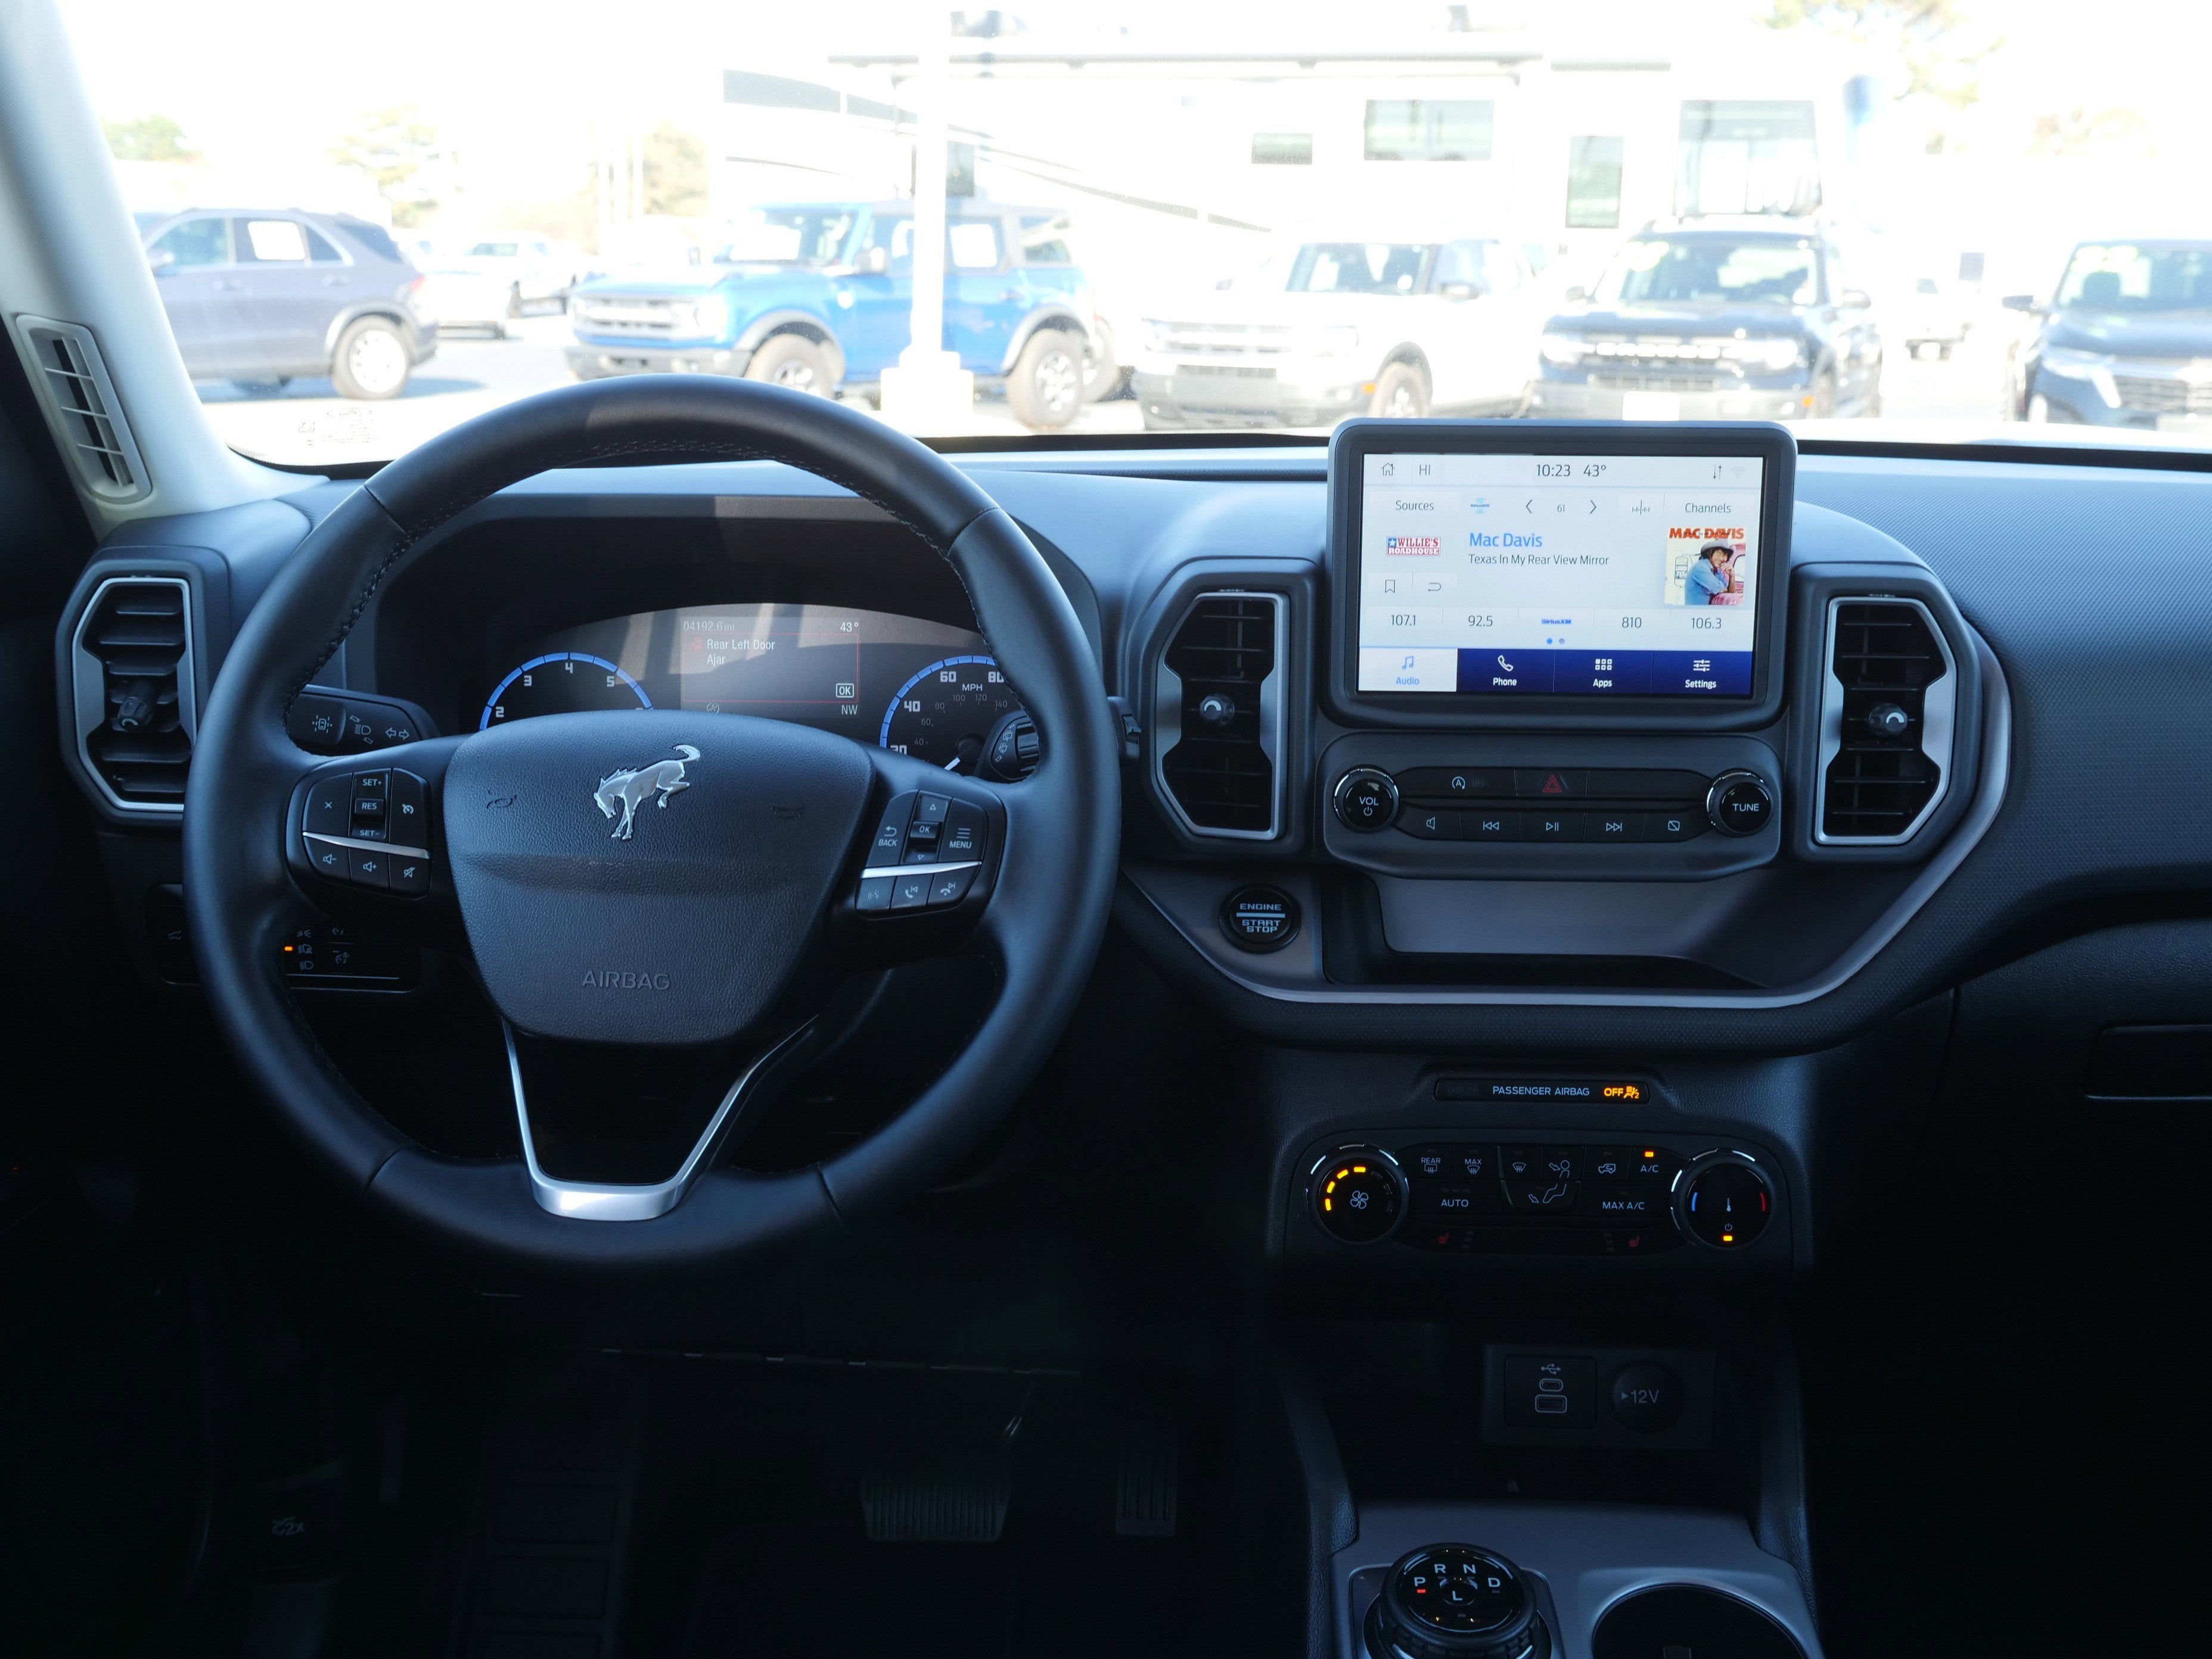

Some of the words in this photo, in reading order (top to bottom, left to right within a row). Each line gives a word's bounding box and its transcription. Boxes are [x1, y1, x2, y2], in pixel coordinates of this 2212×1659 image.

[1419, 464, 1431, 476] HI
[1536, 464, 1571, 477] 10:23
[1583, 464, 1607, 477] 43°
[1396, 500, 1434, 511] Sources
[1557, 504, 1565, 512] 61
[1685, 502, 1731, 513] Channels
[1669, 528, 1700, 539] MAC
[1704, 528, 1744, 539] DAVIS
[1397, 537, 1439, 547] WILLIE'S
[1469, 533, 1499, 546] Mac
[1503, 533, 1543, 547] Davis
[1468, 554, 1497, 564] Texas
[1499, 554, 1509, 564] In
[1511, 554, 1526, 566] My
[1528, 555, 1551, 565] Rear
[1553, 555, 1577, 565] View
[1580, 555, 1609, 565] Mirror
[1391, 614, 1416, 626] 107.1
[1468, 615, 1493, 627] 92.5
[1621, 617, 1642, 629] 810
[1691, 617, 1722, 629] 106.3
[683, 621, 722, 632] 04192.6
[840, 622, 859, 632] 43°
[707, 639, 729, 650] Rear
[732, 639, 750, 650] Left
[753, 639, 776, 650] Door
[707, 654, 726, 667] Ajar
[565, 663, 573, 674] 4
[524, 675, 532, 686] 3
[607, 676, 615, 688] 5
[940, 671, 956, 683] 60
[988, 671, 1005, 683] 80
[1396, 676, 1419, 685] Audio
[1493, 677, 1517, 686] Phone
[962, 683, 983, 691] MPH
[1593, 678, 1613, 688] Apps
[1685, 679, 1717, 689] Settings
[839, 686, 851, 695] OK
[975, 693, 987, 701] 120
[904, 700, 921, 712] 40
[995, 700, 1008, 708] 140
[495, 706, 504, 718] 2
[841, 704, 858, 715] NW
[914, 738, 924, 746] 40
[362, 802, 377, 810] RES
[1359, 796, 1380, 806] VOL
[1732, 803, 1760, 812] TUNE
[919, 825, 931, 834] OK
[949, 841, 973, 849] MENU
[583, 970, 670, 991] AIRBAG
[1493, 1086, 1551, 1096] PASSENGER
[1554, 1086, 1590, 1096] AIRBAG
[1604, 1088, 1624, 1096] OFF
[1640, 1164, 1659, 1173] A/C
[1441, 1199, 1469, 1207] AUTO
[1602, 1201, 1624, 1210] MAX
[1626, 1201, 1645, 1210] A/C
[1630, 1389, 1660, 1404] 12V
[1434, 1564, 1446, 1574] R
[1463, 1564, 1477, 1574] N
[1413, 1577, 1426, 1587] P
[1487, 1577, 1501, 1587] D
[1452, 1590, 1462, 1601] L
